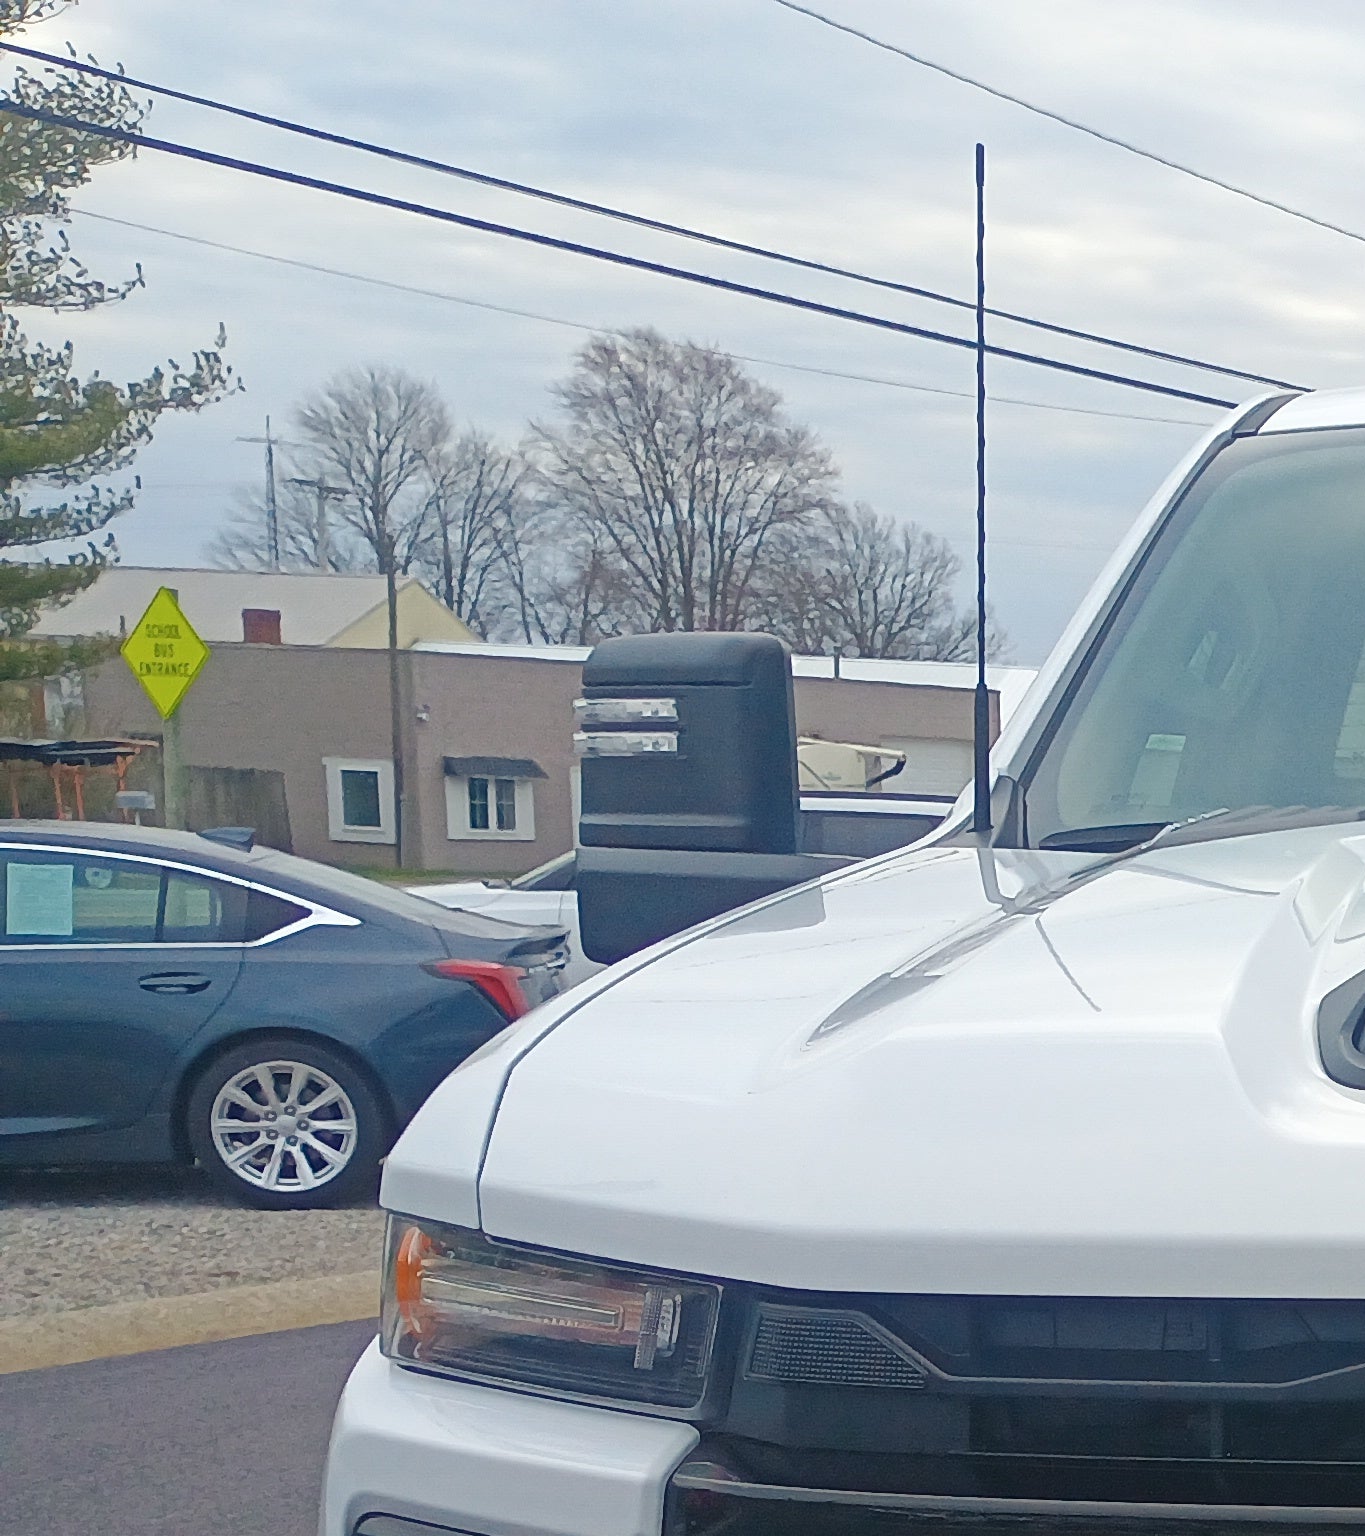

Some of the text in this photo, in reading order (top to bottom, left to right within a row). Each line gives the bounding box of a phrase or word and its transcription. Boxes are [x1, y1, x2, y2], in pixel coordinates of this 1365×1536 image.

[145, 624, 181, 639] SCHOOL
[153, 643, 174, 658] BUS
[139, 661, 193, 677] ENTRANCE
